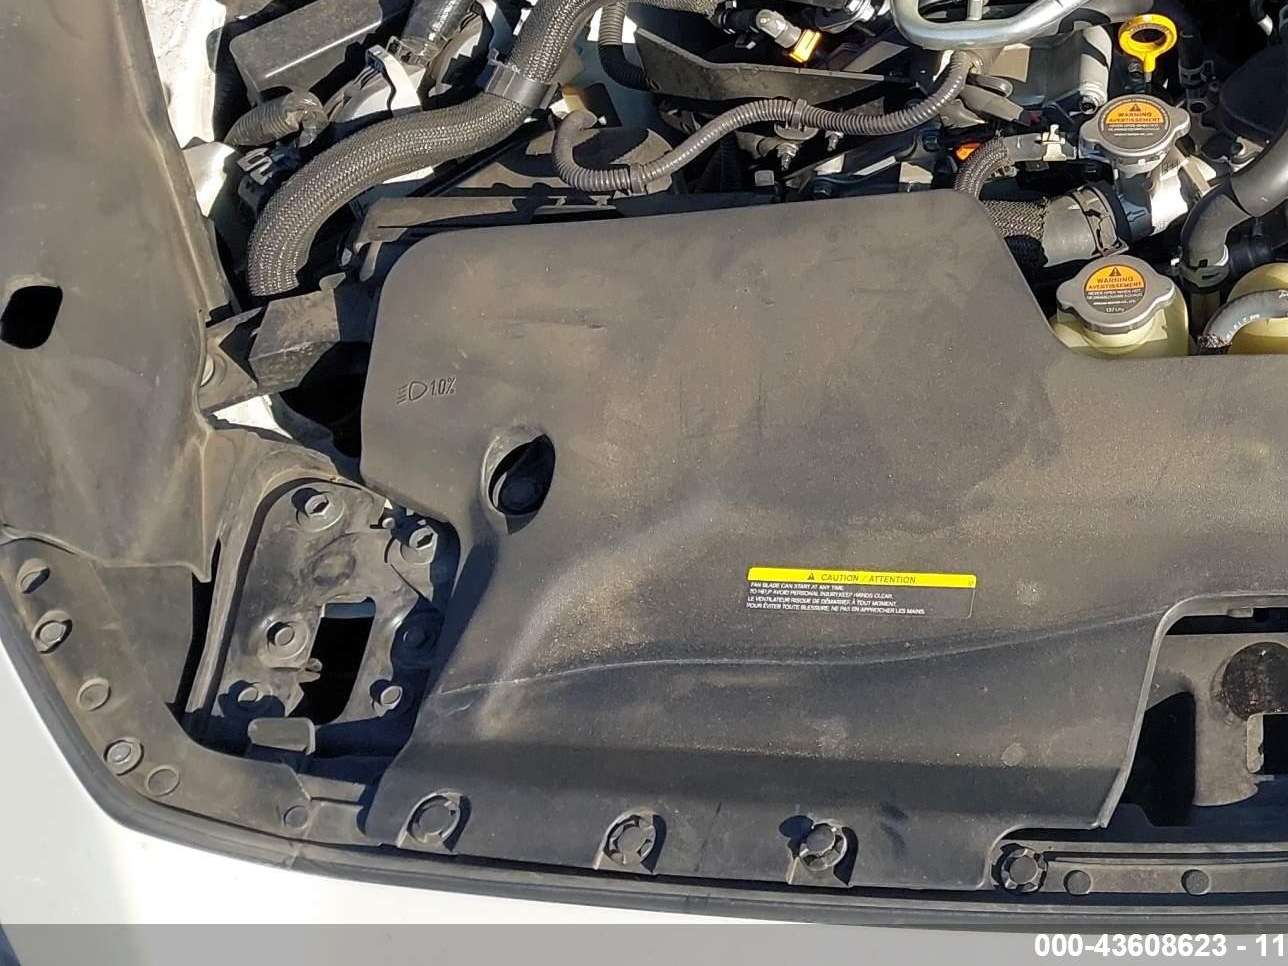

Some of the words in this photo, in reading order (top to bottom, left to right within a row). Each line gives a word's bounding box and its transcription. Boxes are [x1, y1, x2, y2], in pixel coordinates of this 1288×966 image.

[821, 574, 859, 582] CAUTION
[868, 575, 916, 584] ATTENTION
[763, 601, 781, 609] ÉVITER
